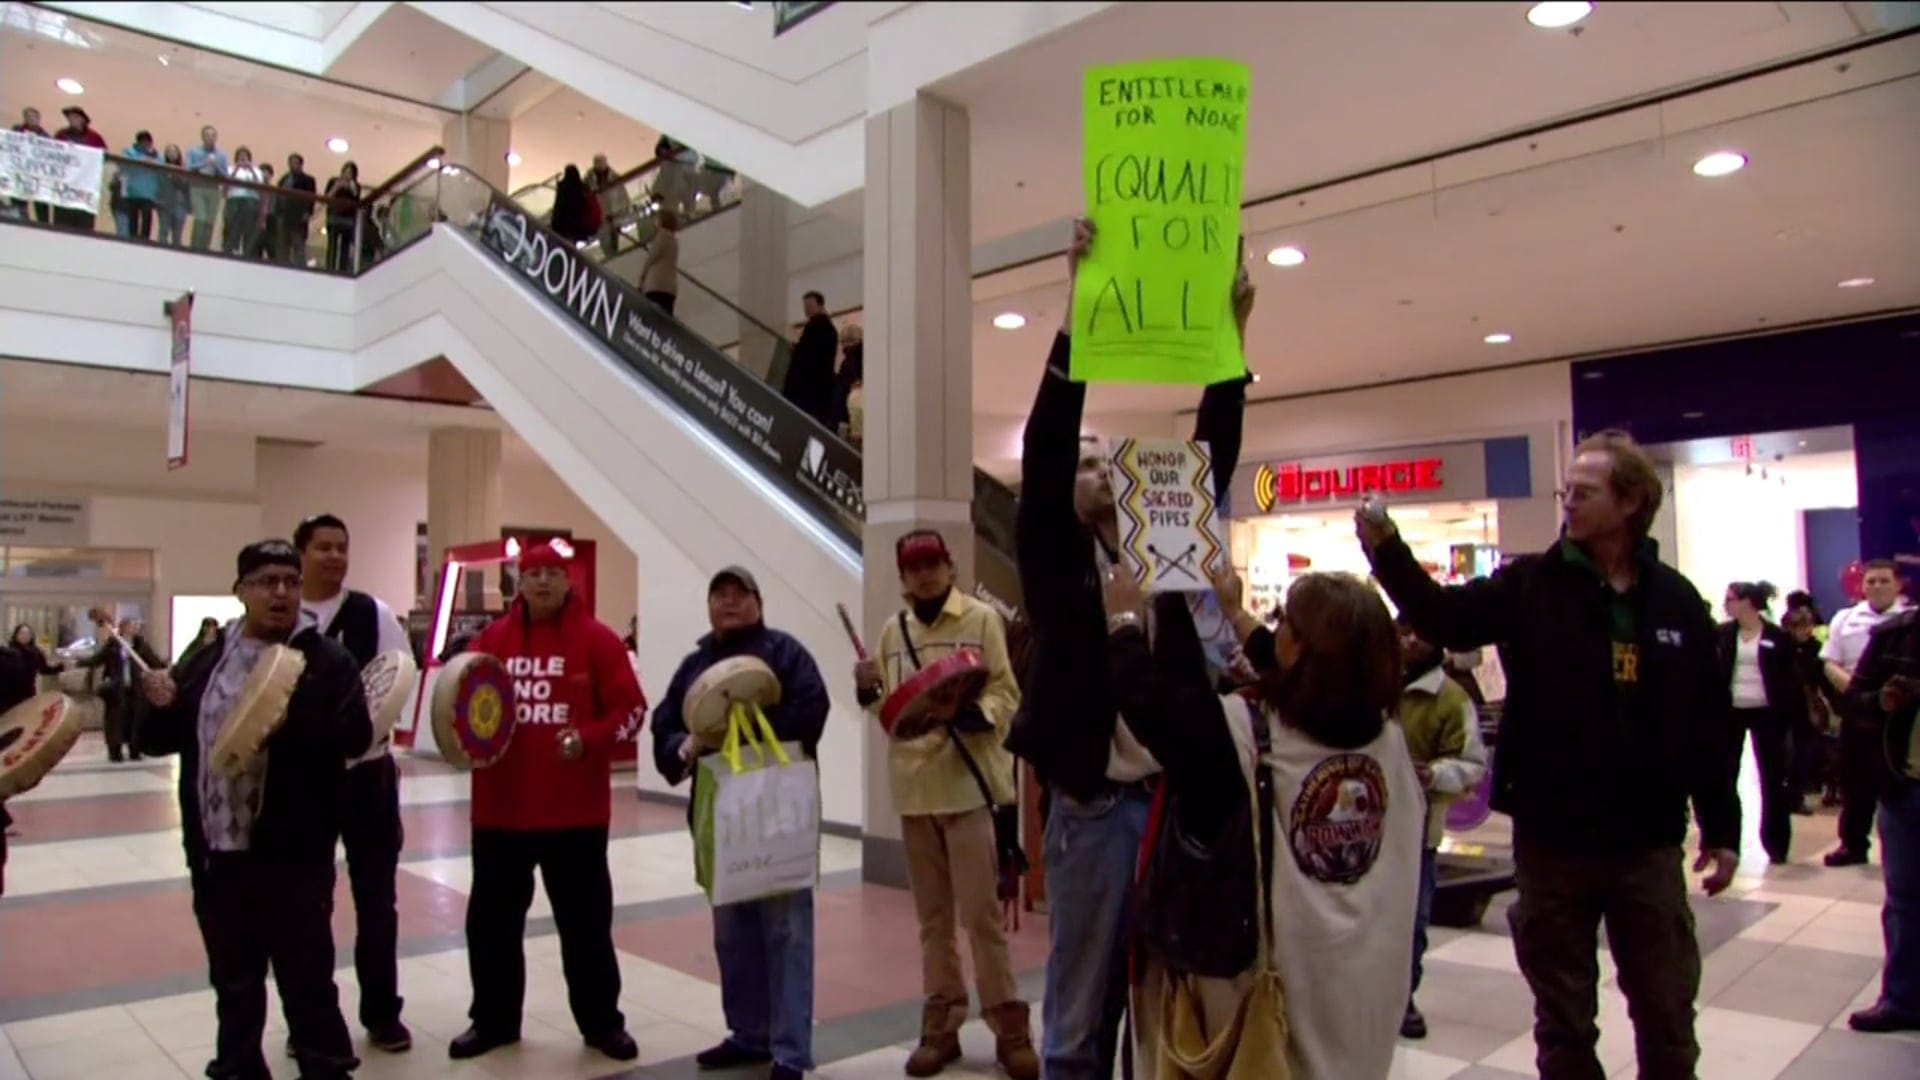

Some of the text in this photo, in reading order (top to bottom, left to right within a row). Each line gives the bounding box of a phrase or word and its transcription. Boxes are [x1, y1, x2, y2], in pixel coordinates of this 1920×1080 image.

[1115, 104, 1155, 128] FOR
[1131, 213, 1222, 256] FOR
[526, 231, 623, 339] DOWN
[1089, 276, 1214, 336] ALL
[727, 385, 747, 415] You
[1136, 451, 1187, 469] HONOR
[1150, 469, 1179, 487] OUR
[1142, 488, 1194, 508] SACRED
[1149, 509, 1190, 528] PIPES
[506, 655, 565, 677] IDLE
[514, 679, 552, 700] NO
[515, 702, 569, 725] ORE
